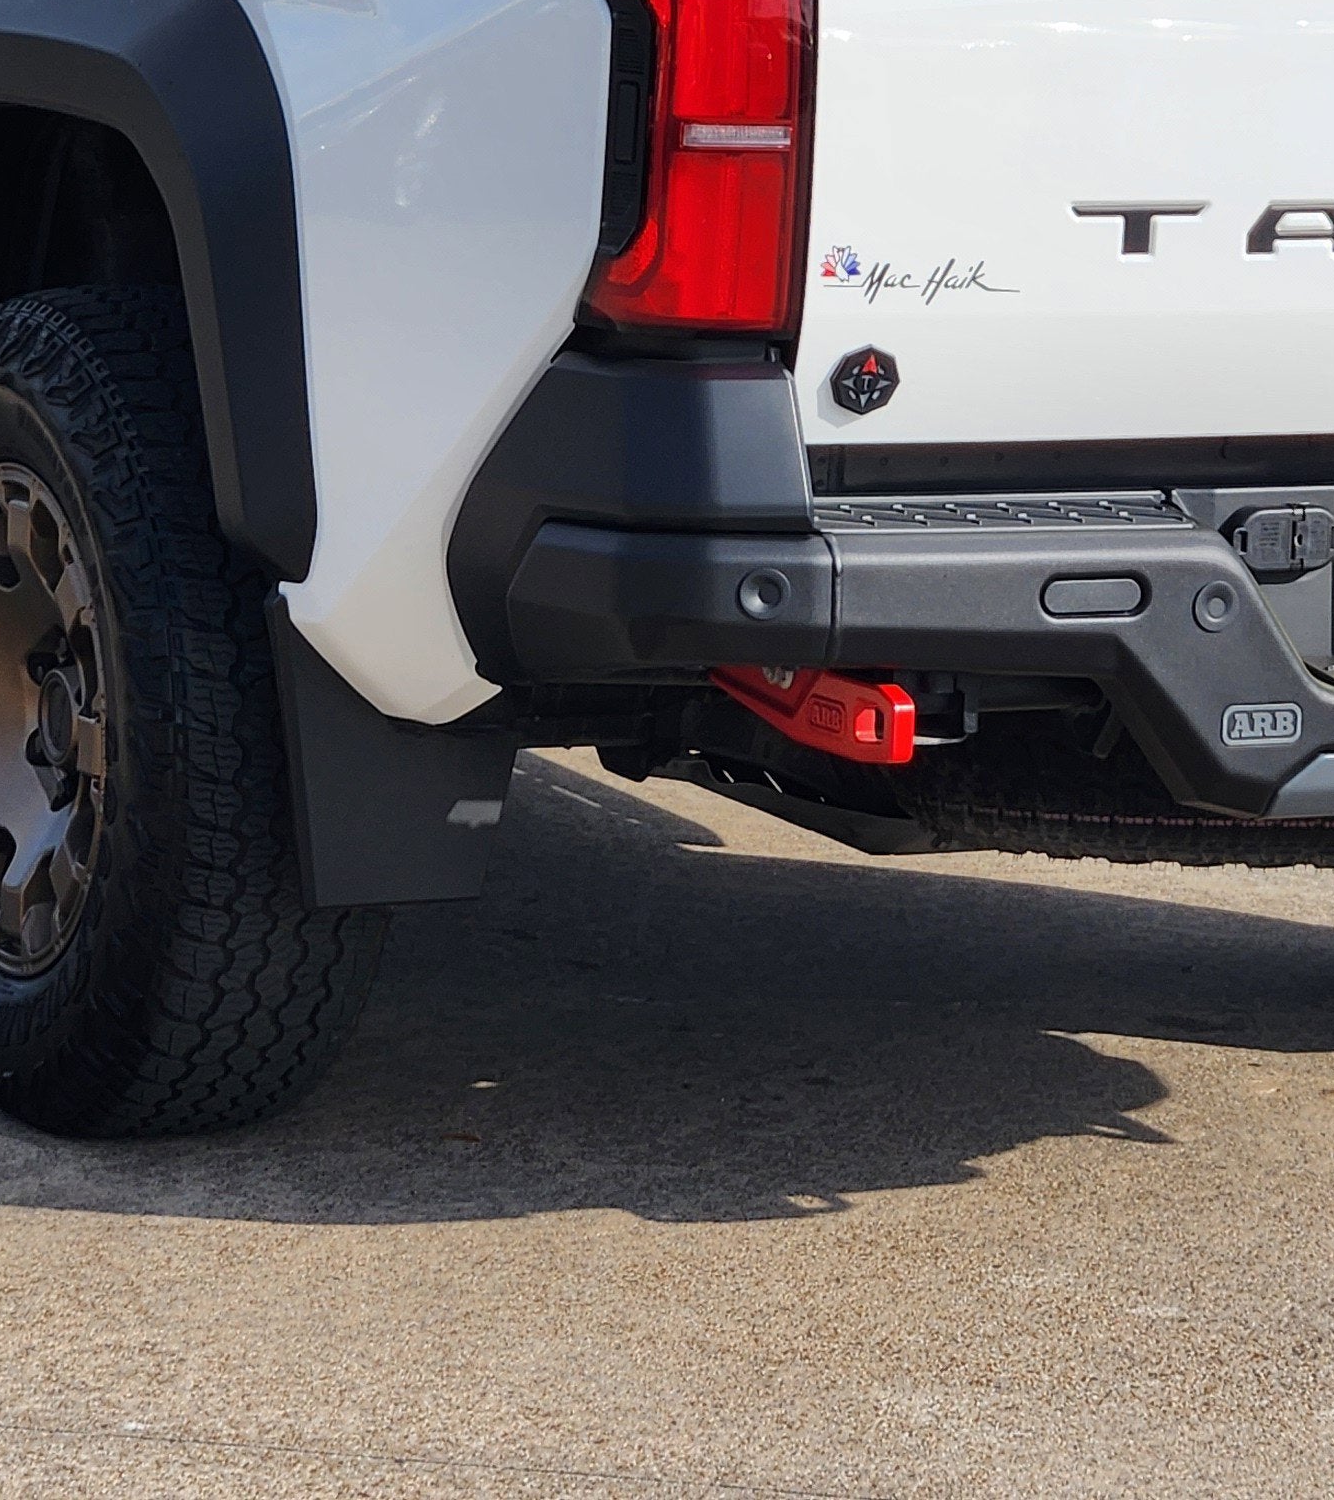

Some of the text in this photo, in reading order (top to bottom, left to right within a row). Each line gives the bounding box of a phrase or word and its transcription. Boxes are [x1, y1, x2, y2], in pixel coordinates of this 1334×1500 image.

[860, 258, 1021, 305] Mac Haik
[1228, 709, 1297, 740] ARB
